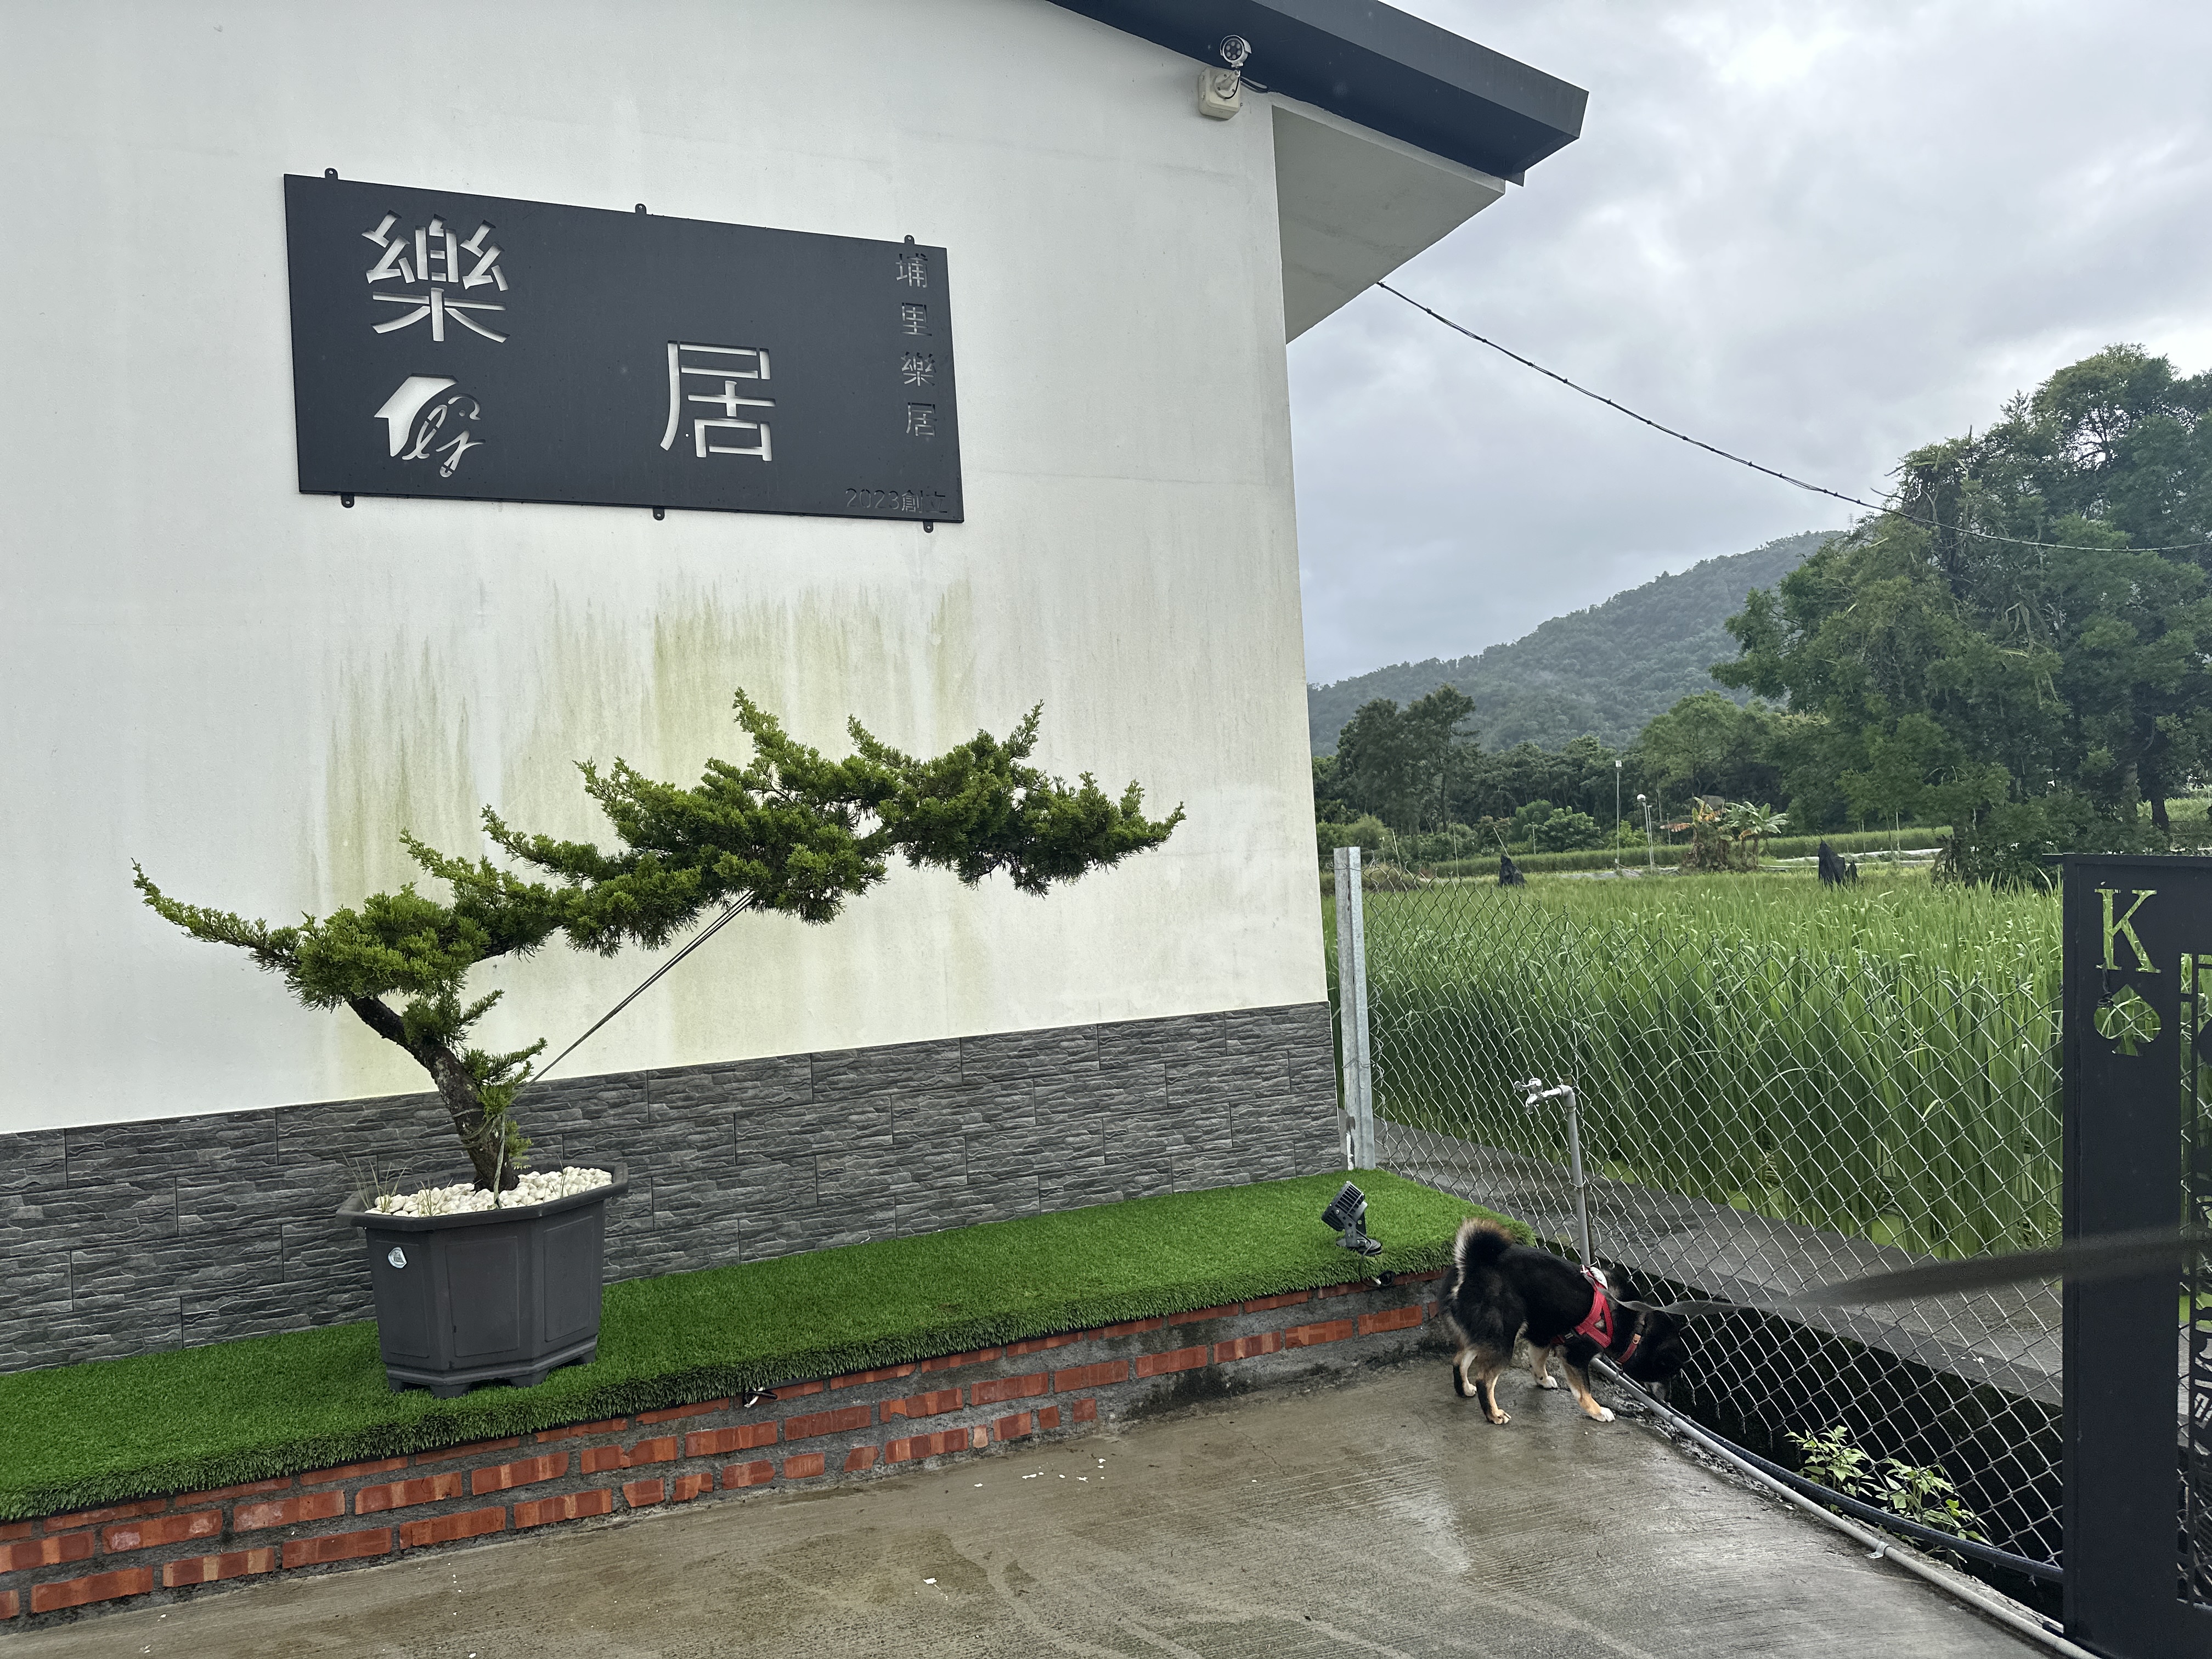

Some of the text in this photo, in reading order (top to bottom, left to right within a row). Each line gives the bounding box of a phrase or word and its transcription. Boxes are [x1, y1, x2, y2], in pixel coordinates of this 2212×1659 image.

[362, 210, 511, 343] 樂
[659, 340, 776, 461] 居
[895, 253, 938, 437] 埔里樂居
[2094, 889, 2161, 974] K
